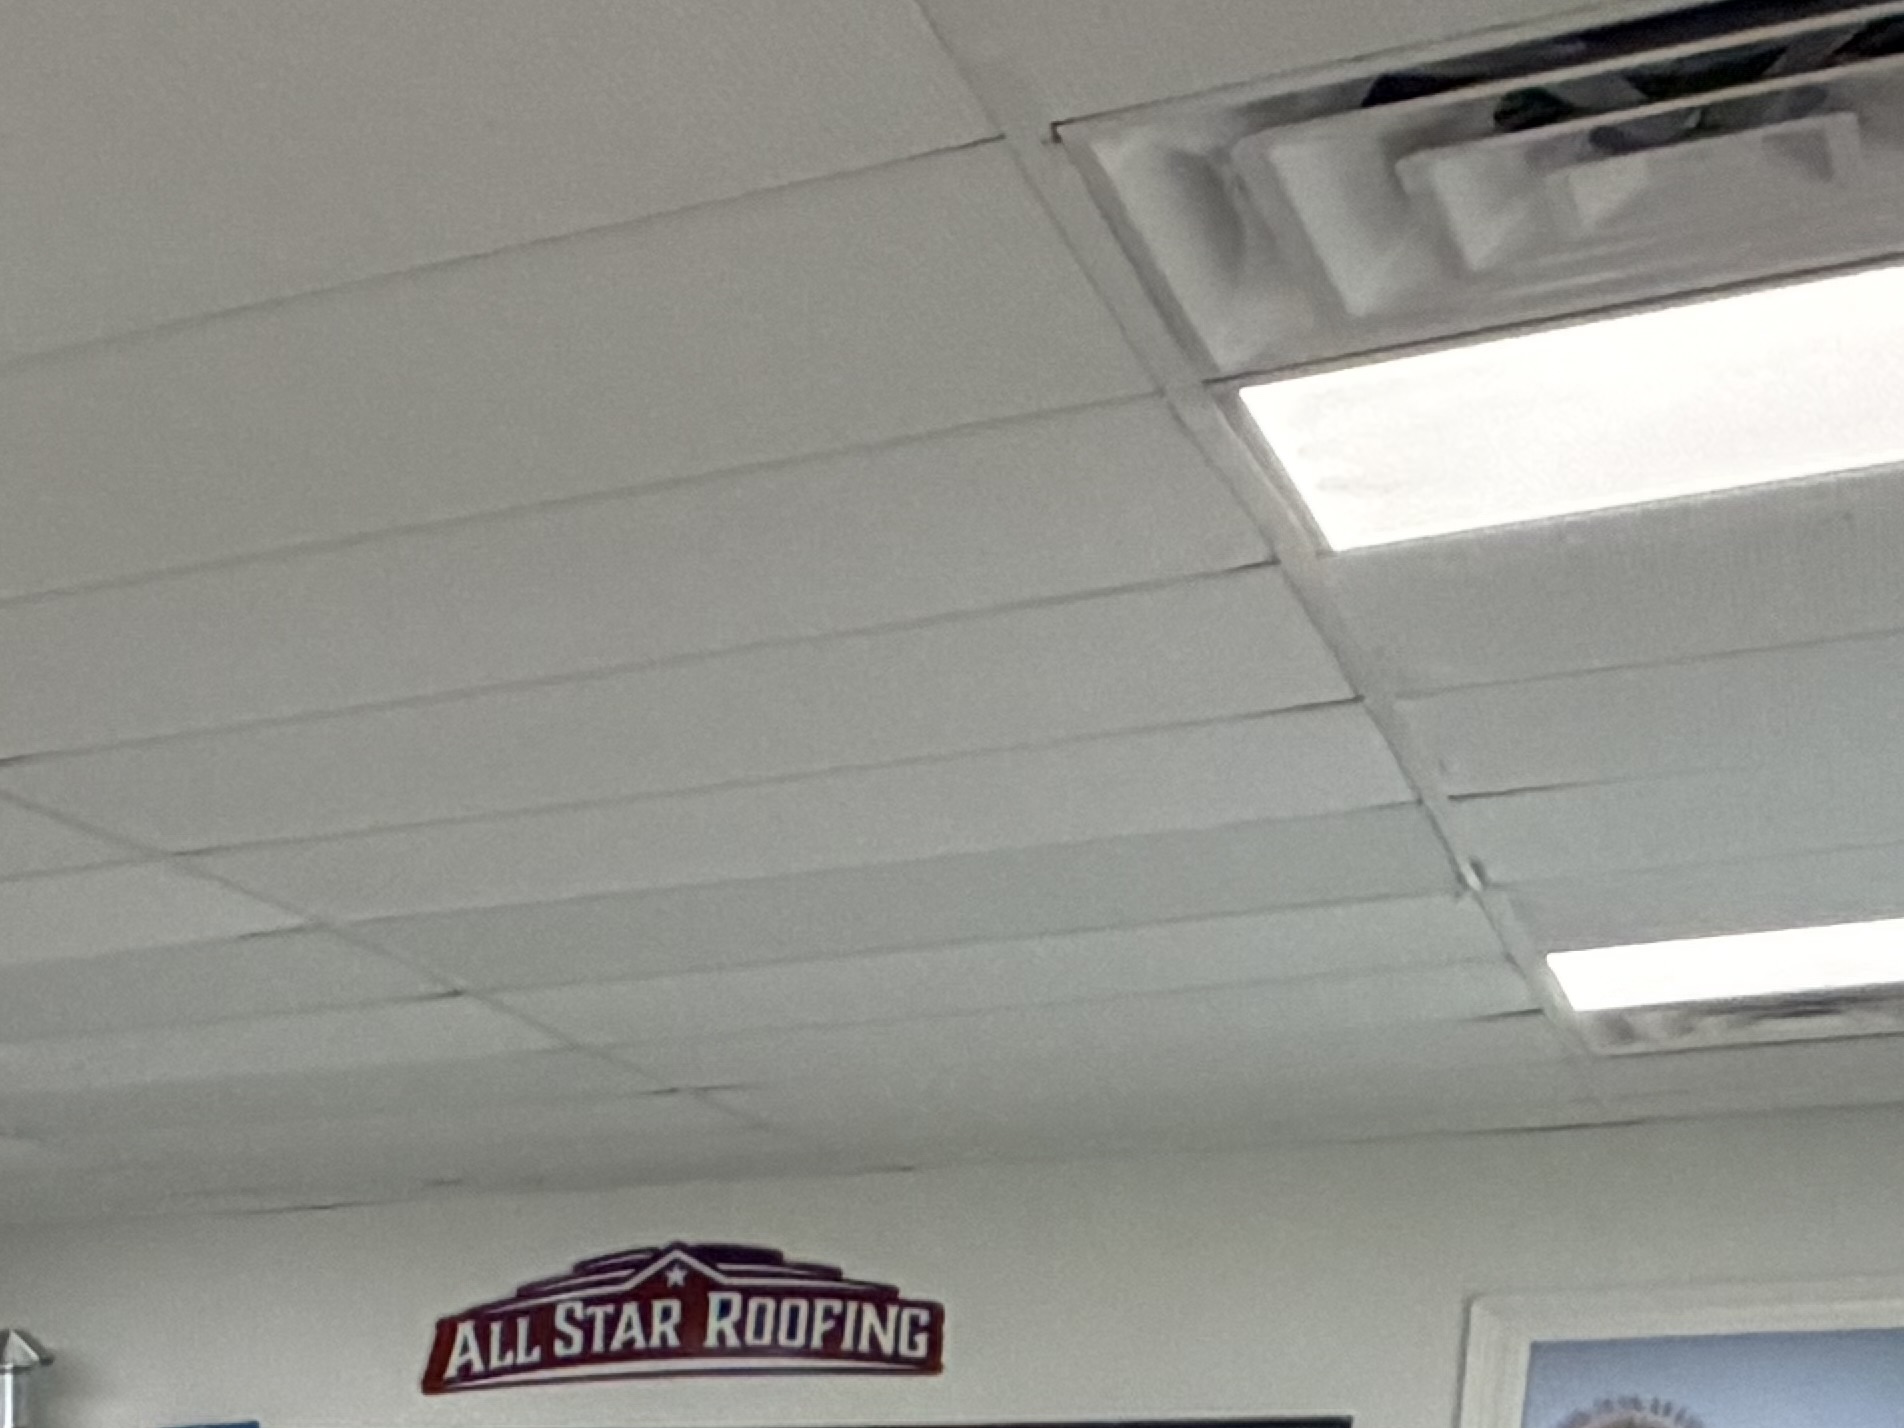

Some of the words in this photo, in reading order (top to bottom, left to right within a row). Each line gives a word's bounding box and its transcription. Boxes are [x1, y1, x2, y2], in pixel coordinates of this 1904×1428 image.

[443, 1319, 542, 1381] ALL
[553, 1298, 682, 1357] STAR
[703, 1289, 931, 1359] ROOFING
